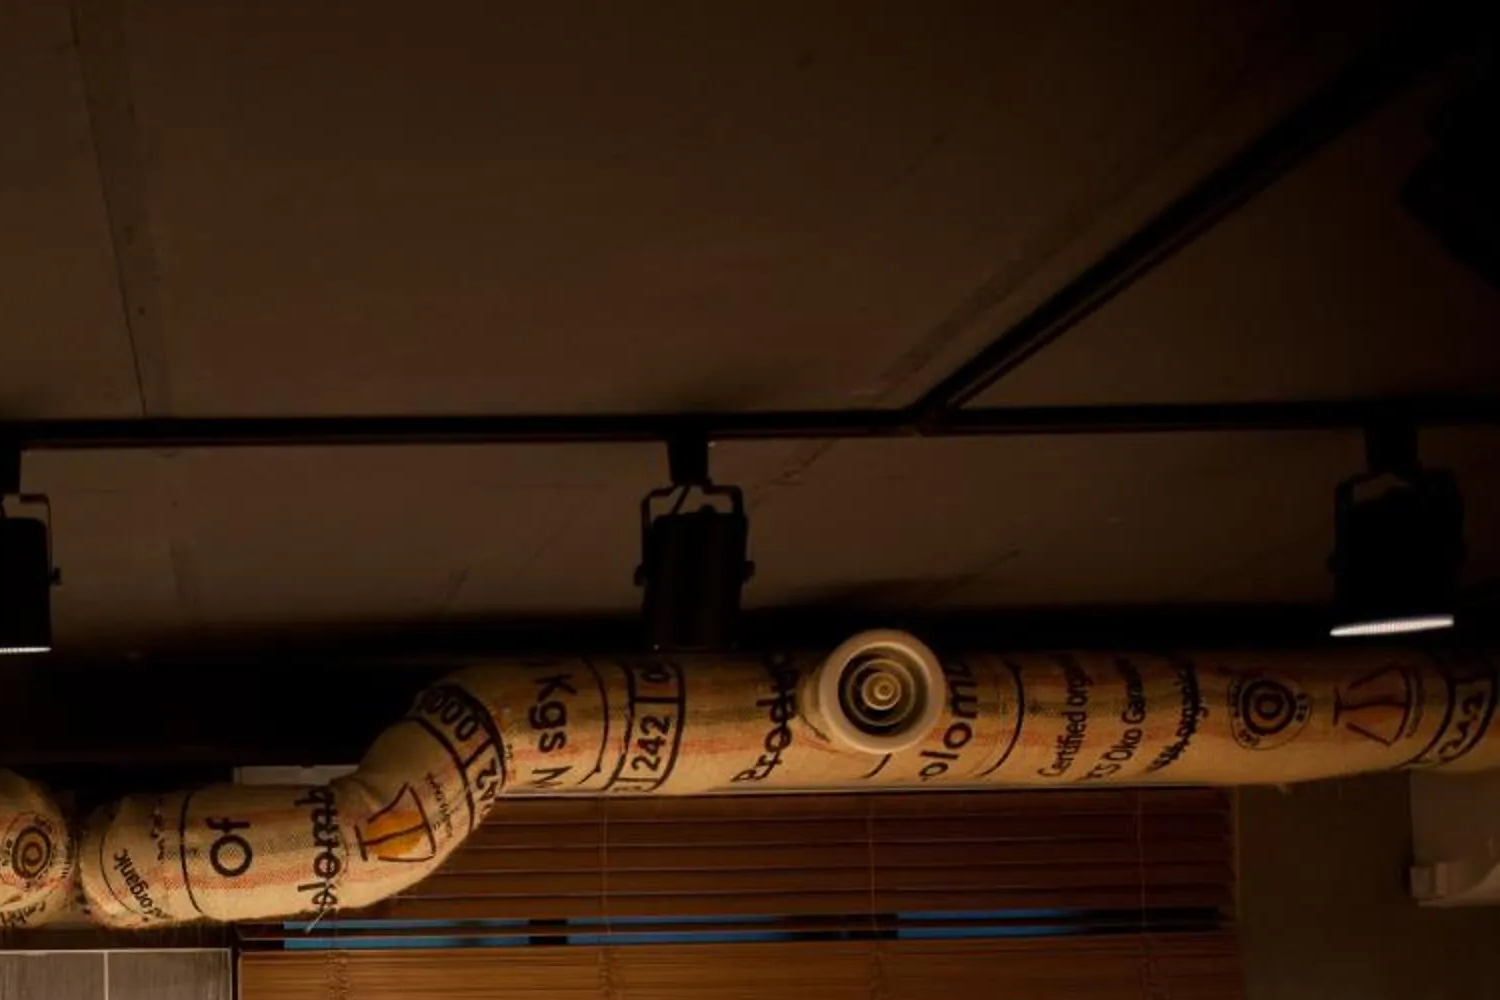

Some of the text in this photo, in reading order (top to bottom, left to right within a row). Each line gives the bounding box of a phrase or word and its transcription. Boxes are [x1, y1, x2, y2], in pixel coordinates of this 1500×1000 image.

[529, 673, 578, 753] Kgs
[630, 715, 672, 772] 242
[205, 815, 253, 877] Of
